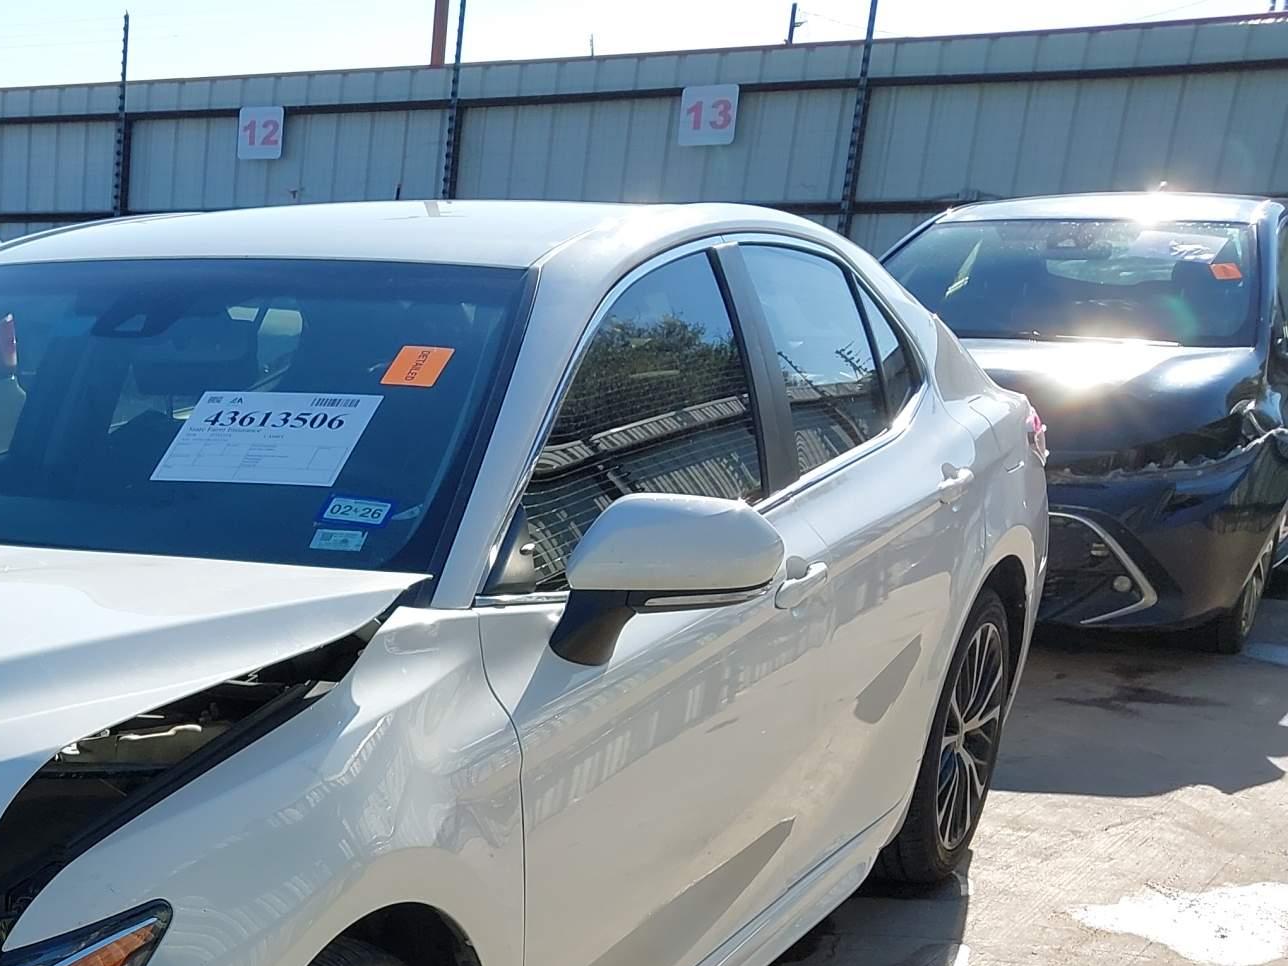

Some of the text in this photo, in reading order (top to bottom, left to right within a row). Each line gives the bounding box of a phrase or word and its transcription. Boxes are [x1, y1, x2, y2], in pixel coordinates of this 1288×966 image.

[686, 99, 732, 130] 13
[243, 119, 280, 146] 12
[203, 409, 346, 431] 43613506
[330, 504, 383, 519] 02 26
